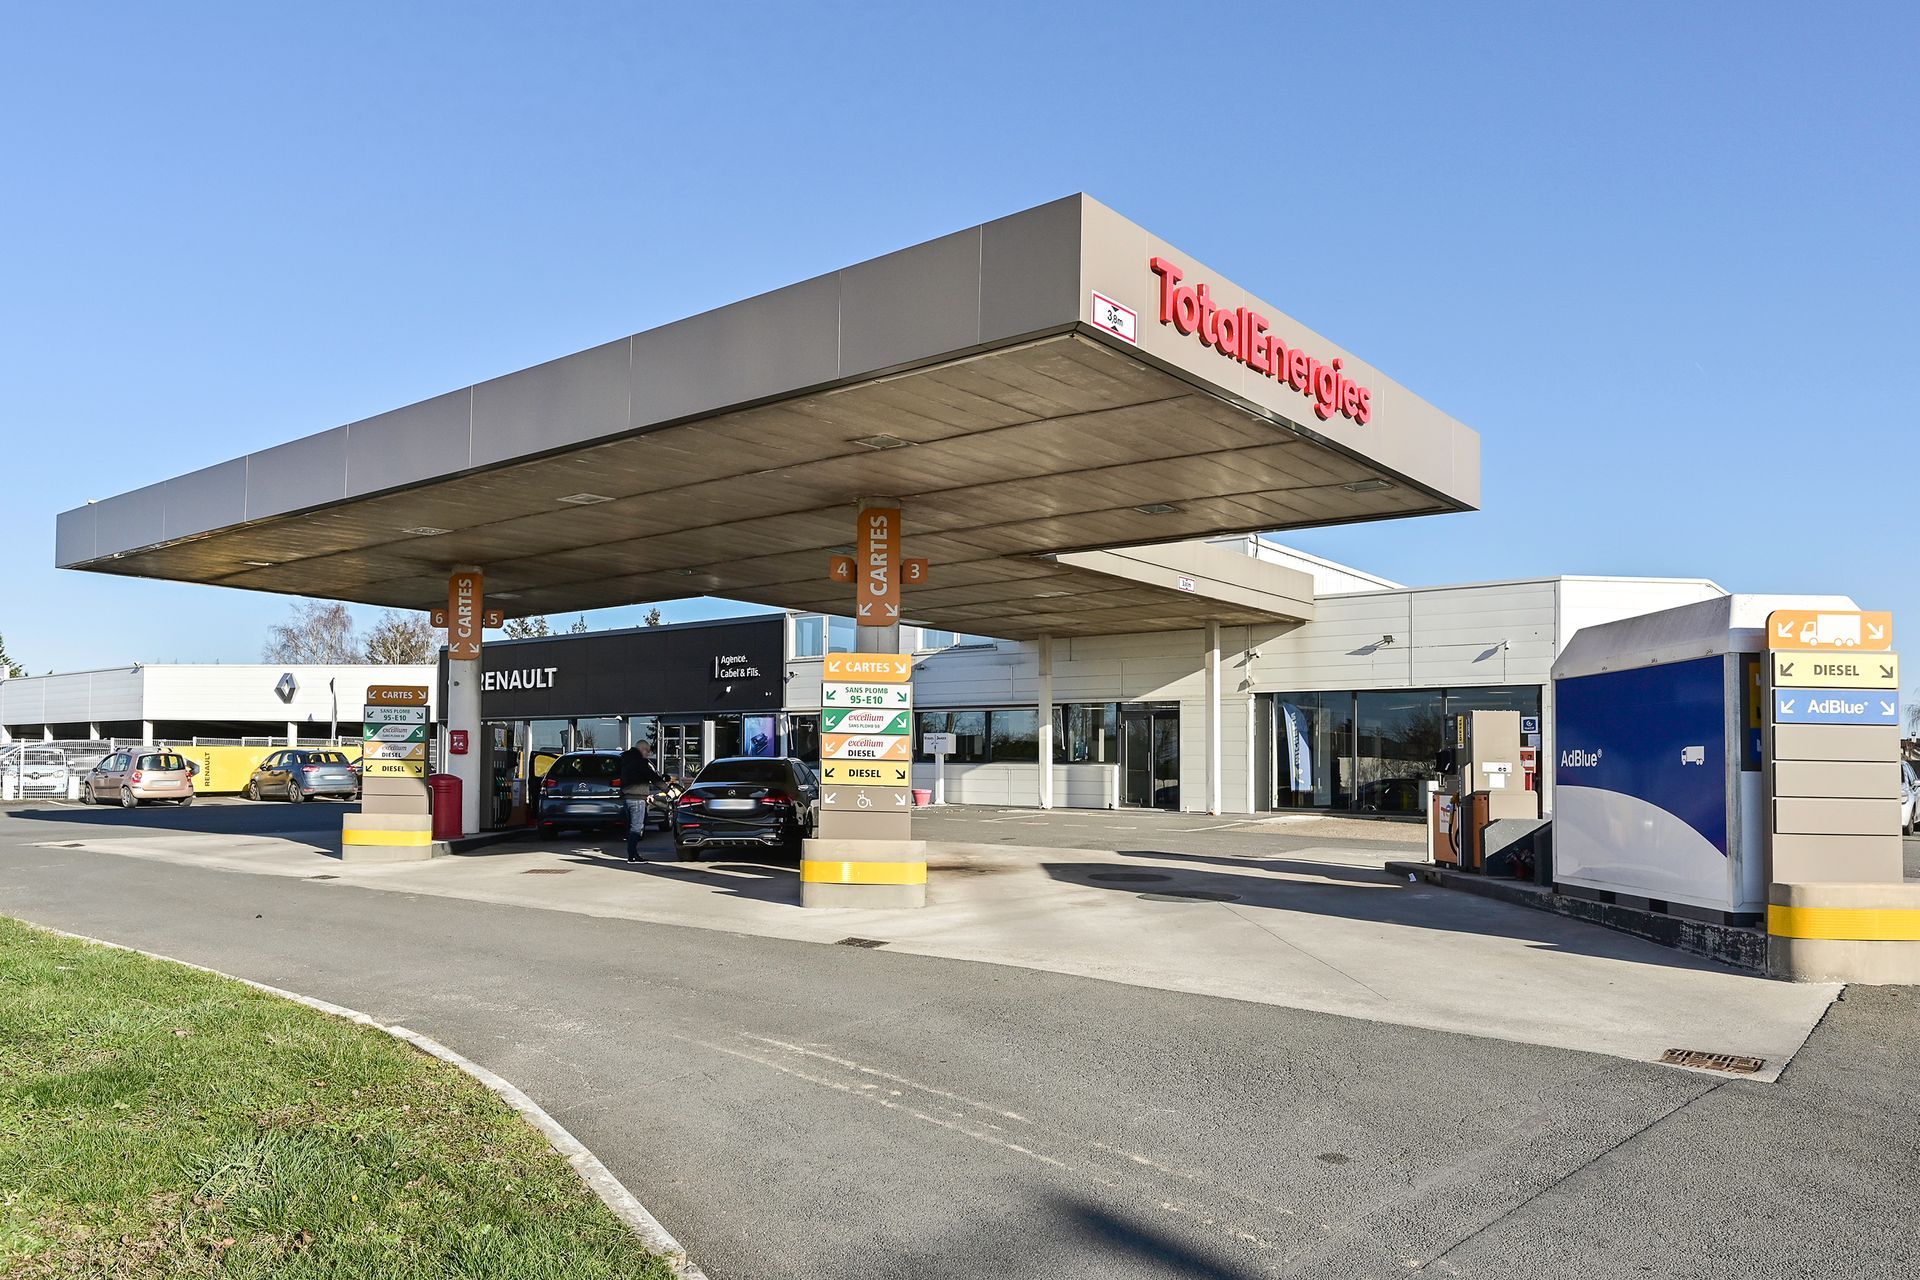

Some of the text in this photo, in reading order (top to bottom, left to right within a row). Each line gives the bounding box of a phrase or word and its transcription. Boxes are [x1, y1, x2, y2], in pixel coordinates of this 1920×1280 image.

[1150, 256, 1372, 426] TotalEnergies
[869, 515, 888, 596] CARTES
[837, 562, 848, 577] 4
[910, 563, 920, 579] 3
[457, 578, 473, 638] CARTES
[435, 612, 443, 624] 6
[490, 613, 498, 625] 5
[740, 669, 746, 677] &
[845, 662, 890, 673] CARTES
[1813, 664, 1860, 676] DIESEL
[381, 691, 413, 699] CARTES
[850, 695, 883, 705] 95-E10
[848, 711, 884, 722] excellium
[847, 738, 884, 748] excellium
[847, 750, 876, 758] DIESEL
[848, 769, 882, 778] DIESEL
